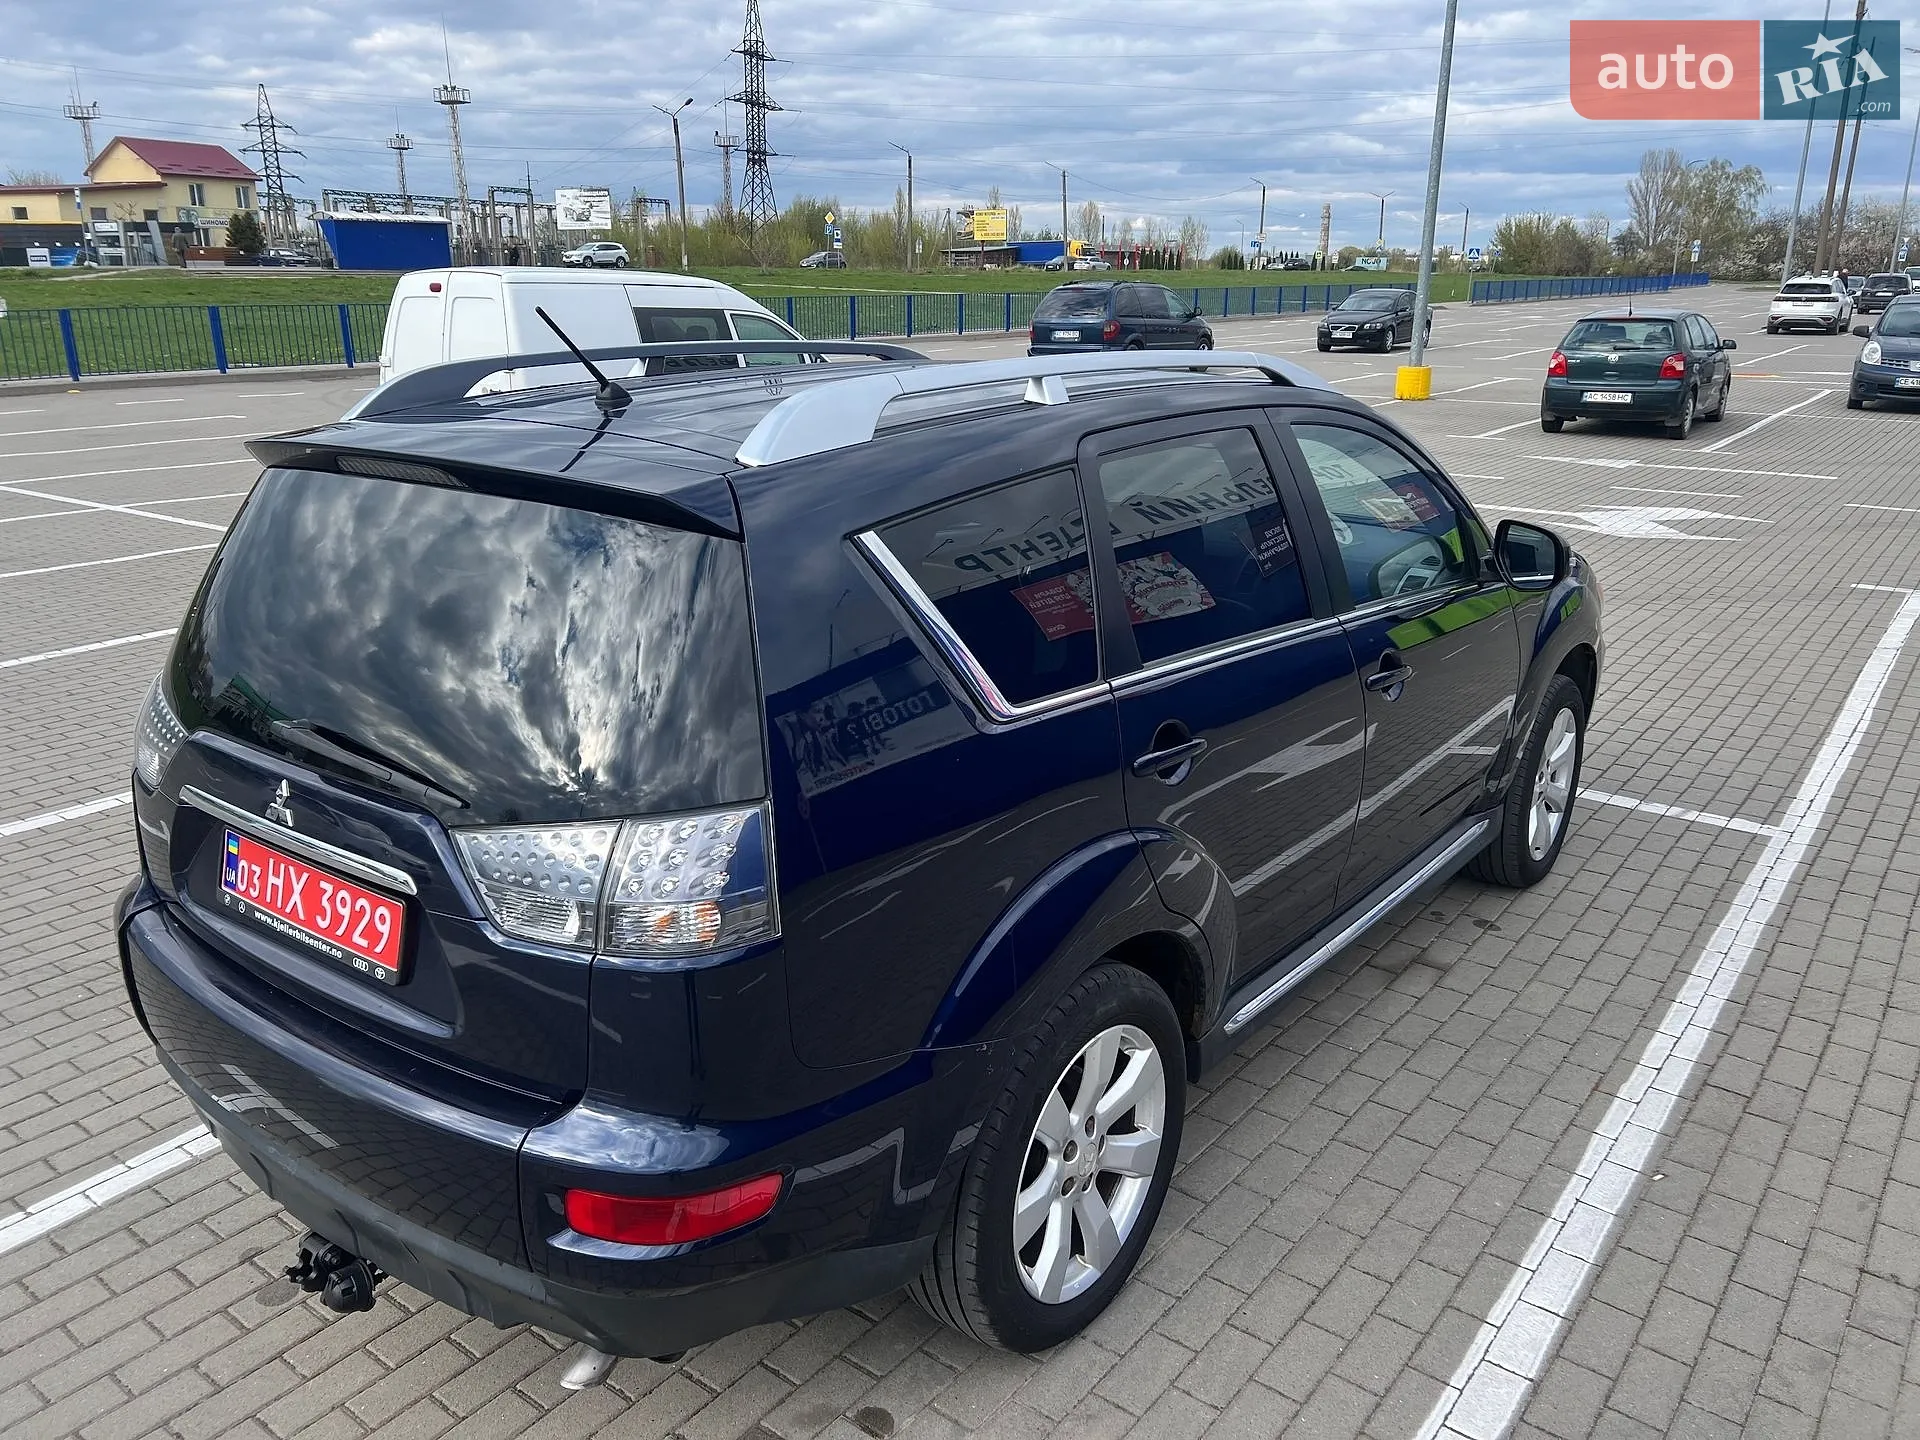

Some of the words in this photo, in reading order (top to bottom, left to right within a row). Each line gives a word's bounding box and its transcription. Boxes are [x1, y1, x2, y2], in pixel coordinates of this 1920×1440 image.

[199, 218, 229, 226] ШИНОМО
[226, 867, 236, 884] UA
[237, 859, 262, 899] 03
[265, 857, 310, 921] HX
[315, 880, 392, 954] 3929
[254, 909, 342, 959] www.kjellerbilsenter.no
